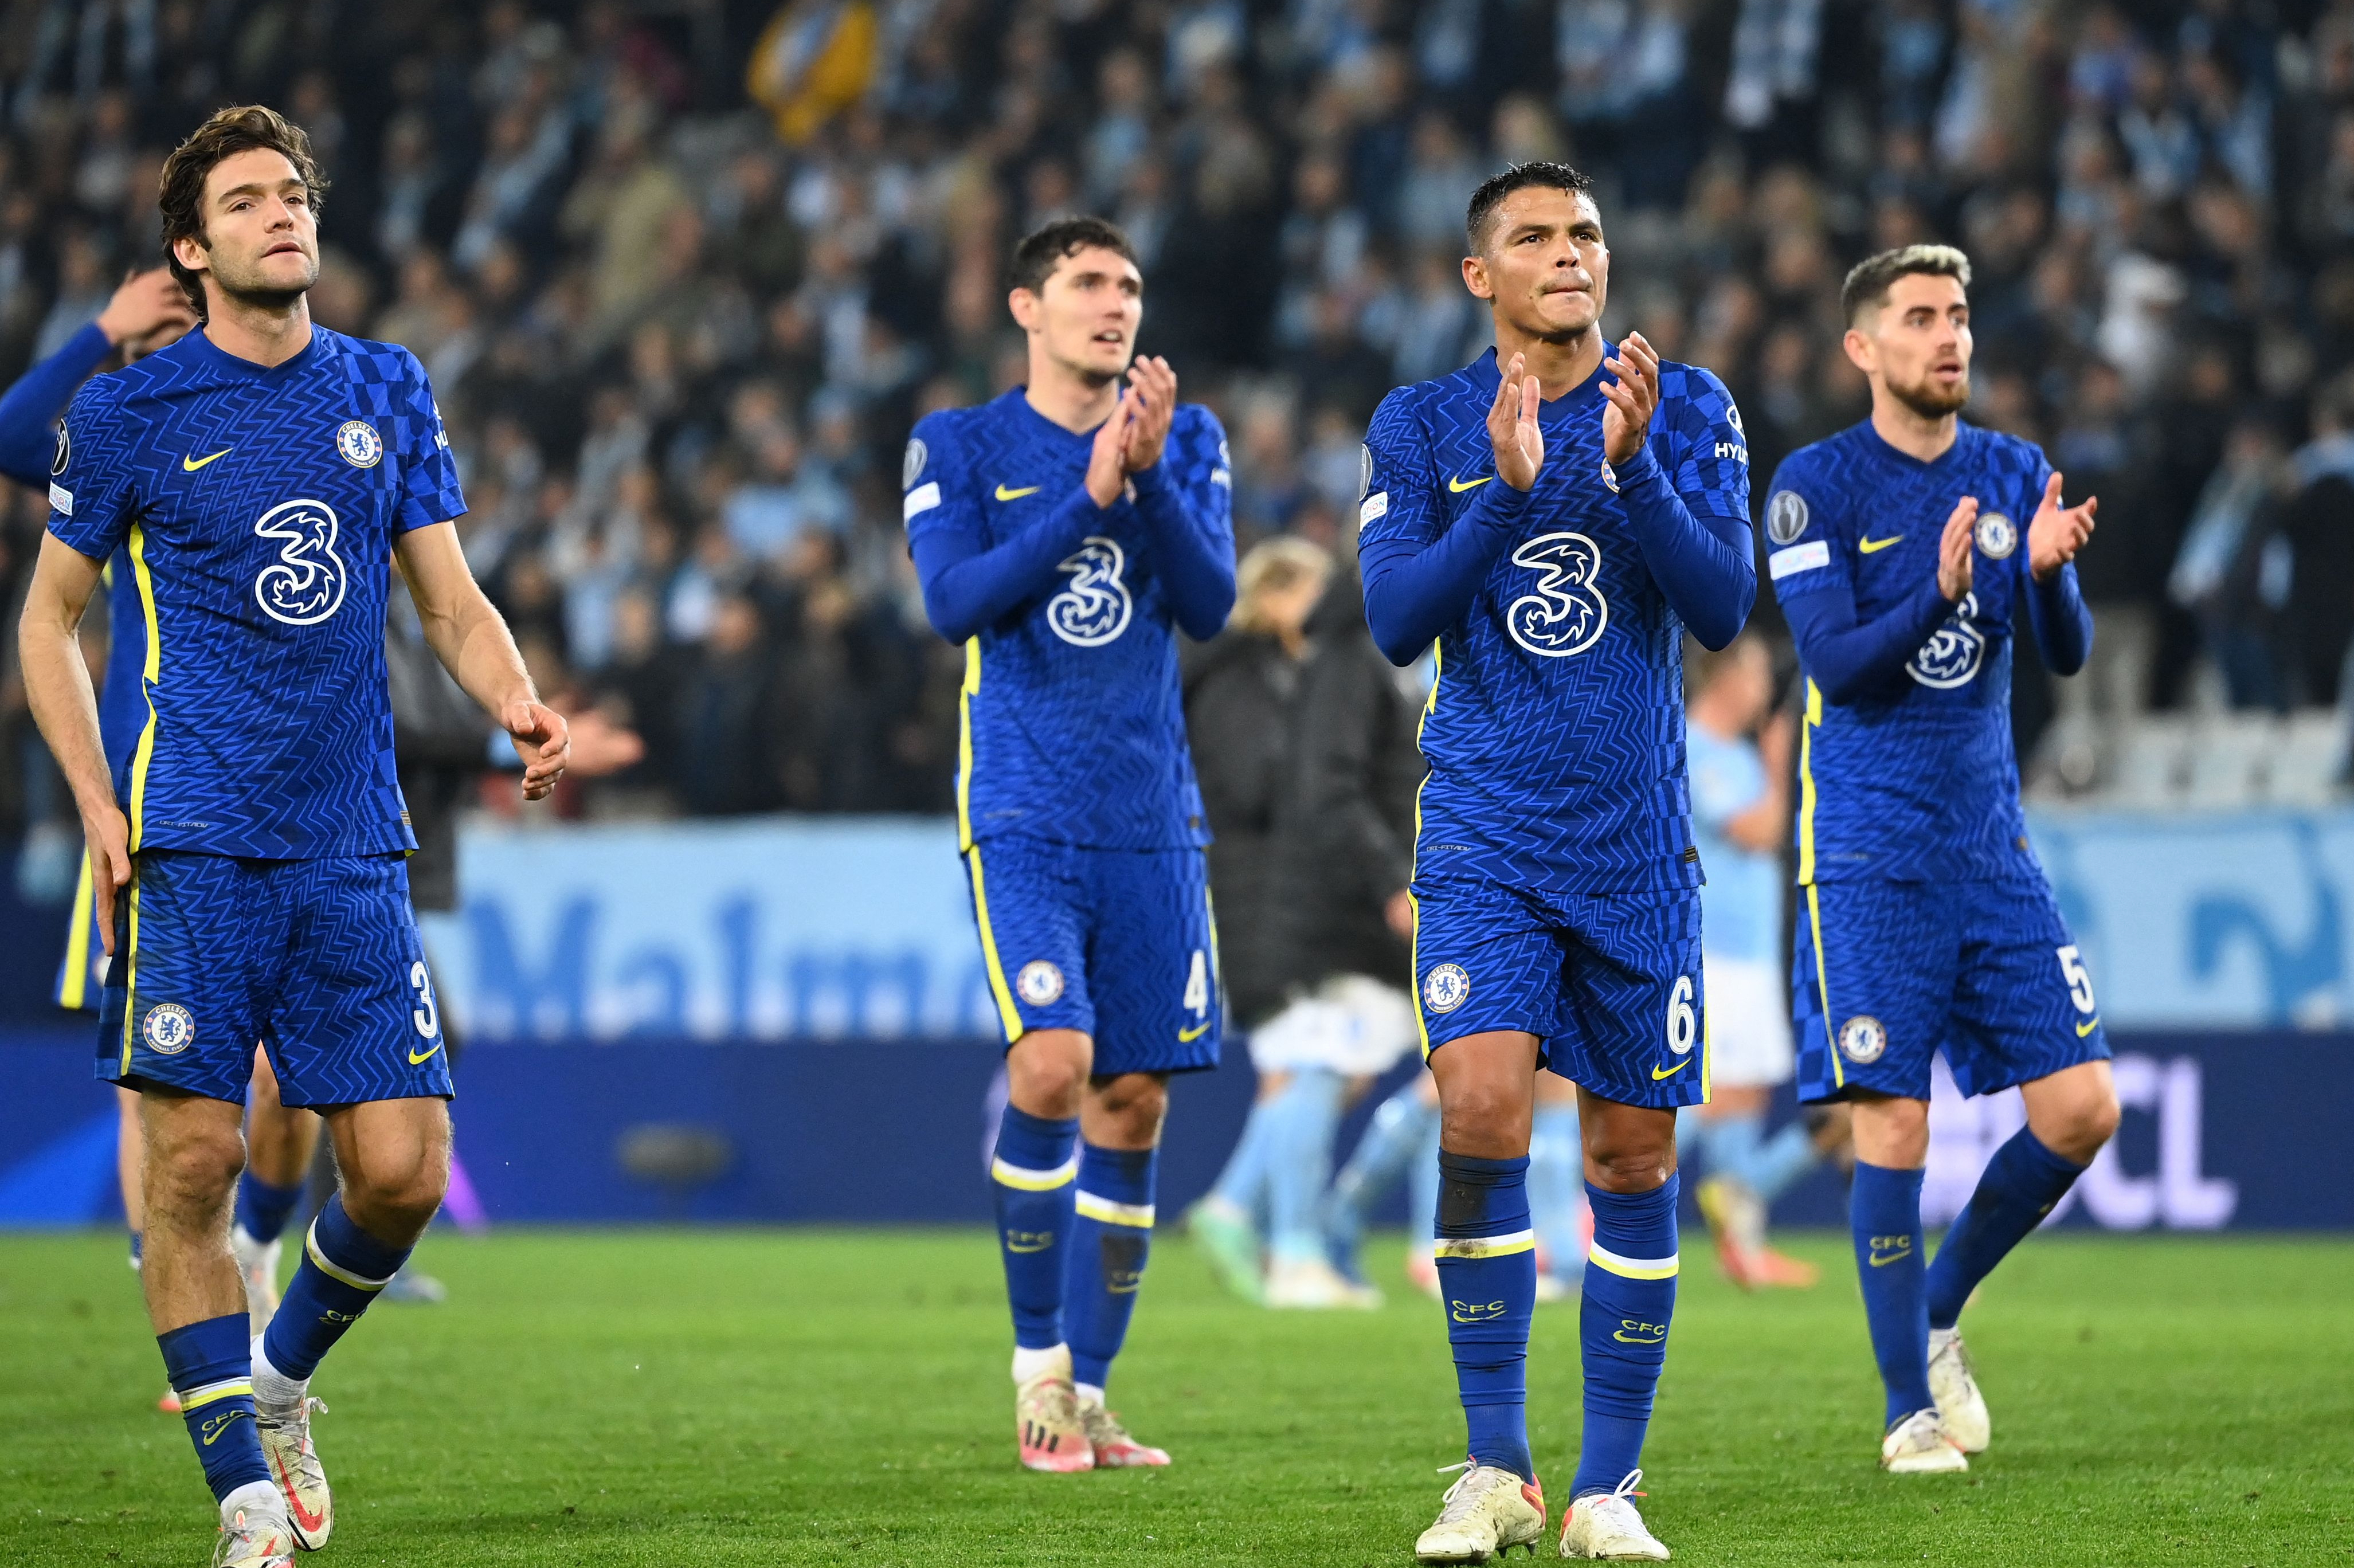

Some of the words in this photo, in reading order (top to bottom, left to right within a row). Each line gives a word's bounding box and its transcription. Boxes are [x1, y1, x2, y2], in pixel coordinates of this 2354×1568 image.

[342, 422, 370, 433] CHELSEA
[1428, 966, 1456, 982] CHELSEA
[2057, 945, 2094, 1014] 5
[1183, 949, 1208, 1018] 4
[410, 961, 437, 1038] 3
[155, 1005, 187, 1020] CHELSEA
[1667, 976, 1695, 1055] 6
[1870, 1235, 1911, 1249] CFC
[1452, 1300, 1505, 1314] CFC
[1621, 1320, 1665, 1335] CFC
